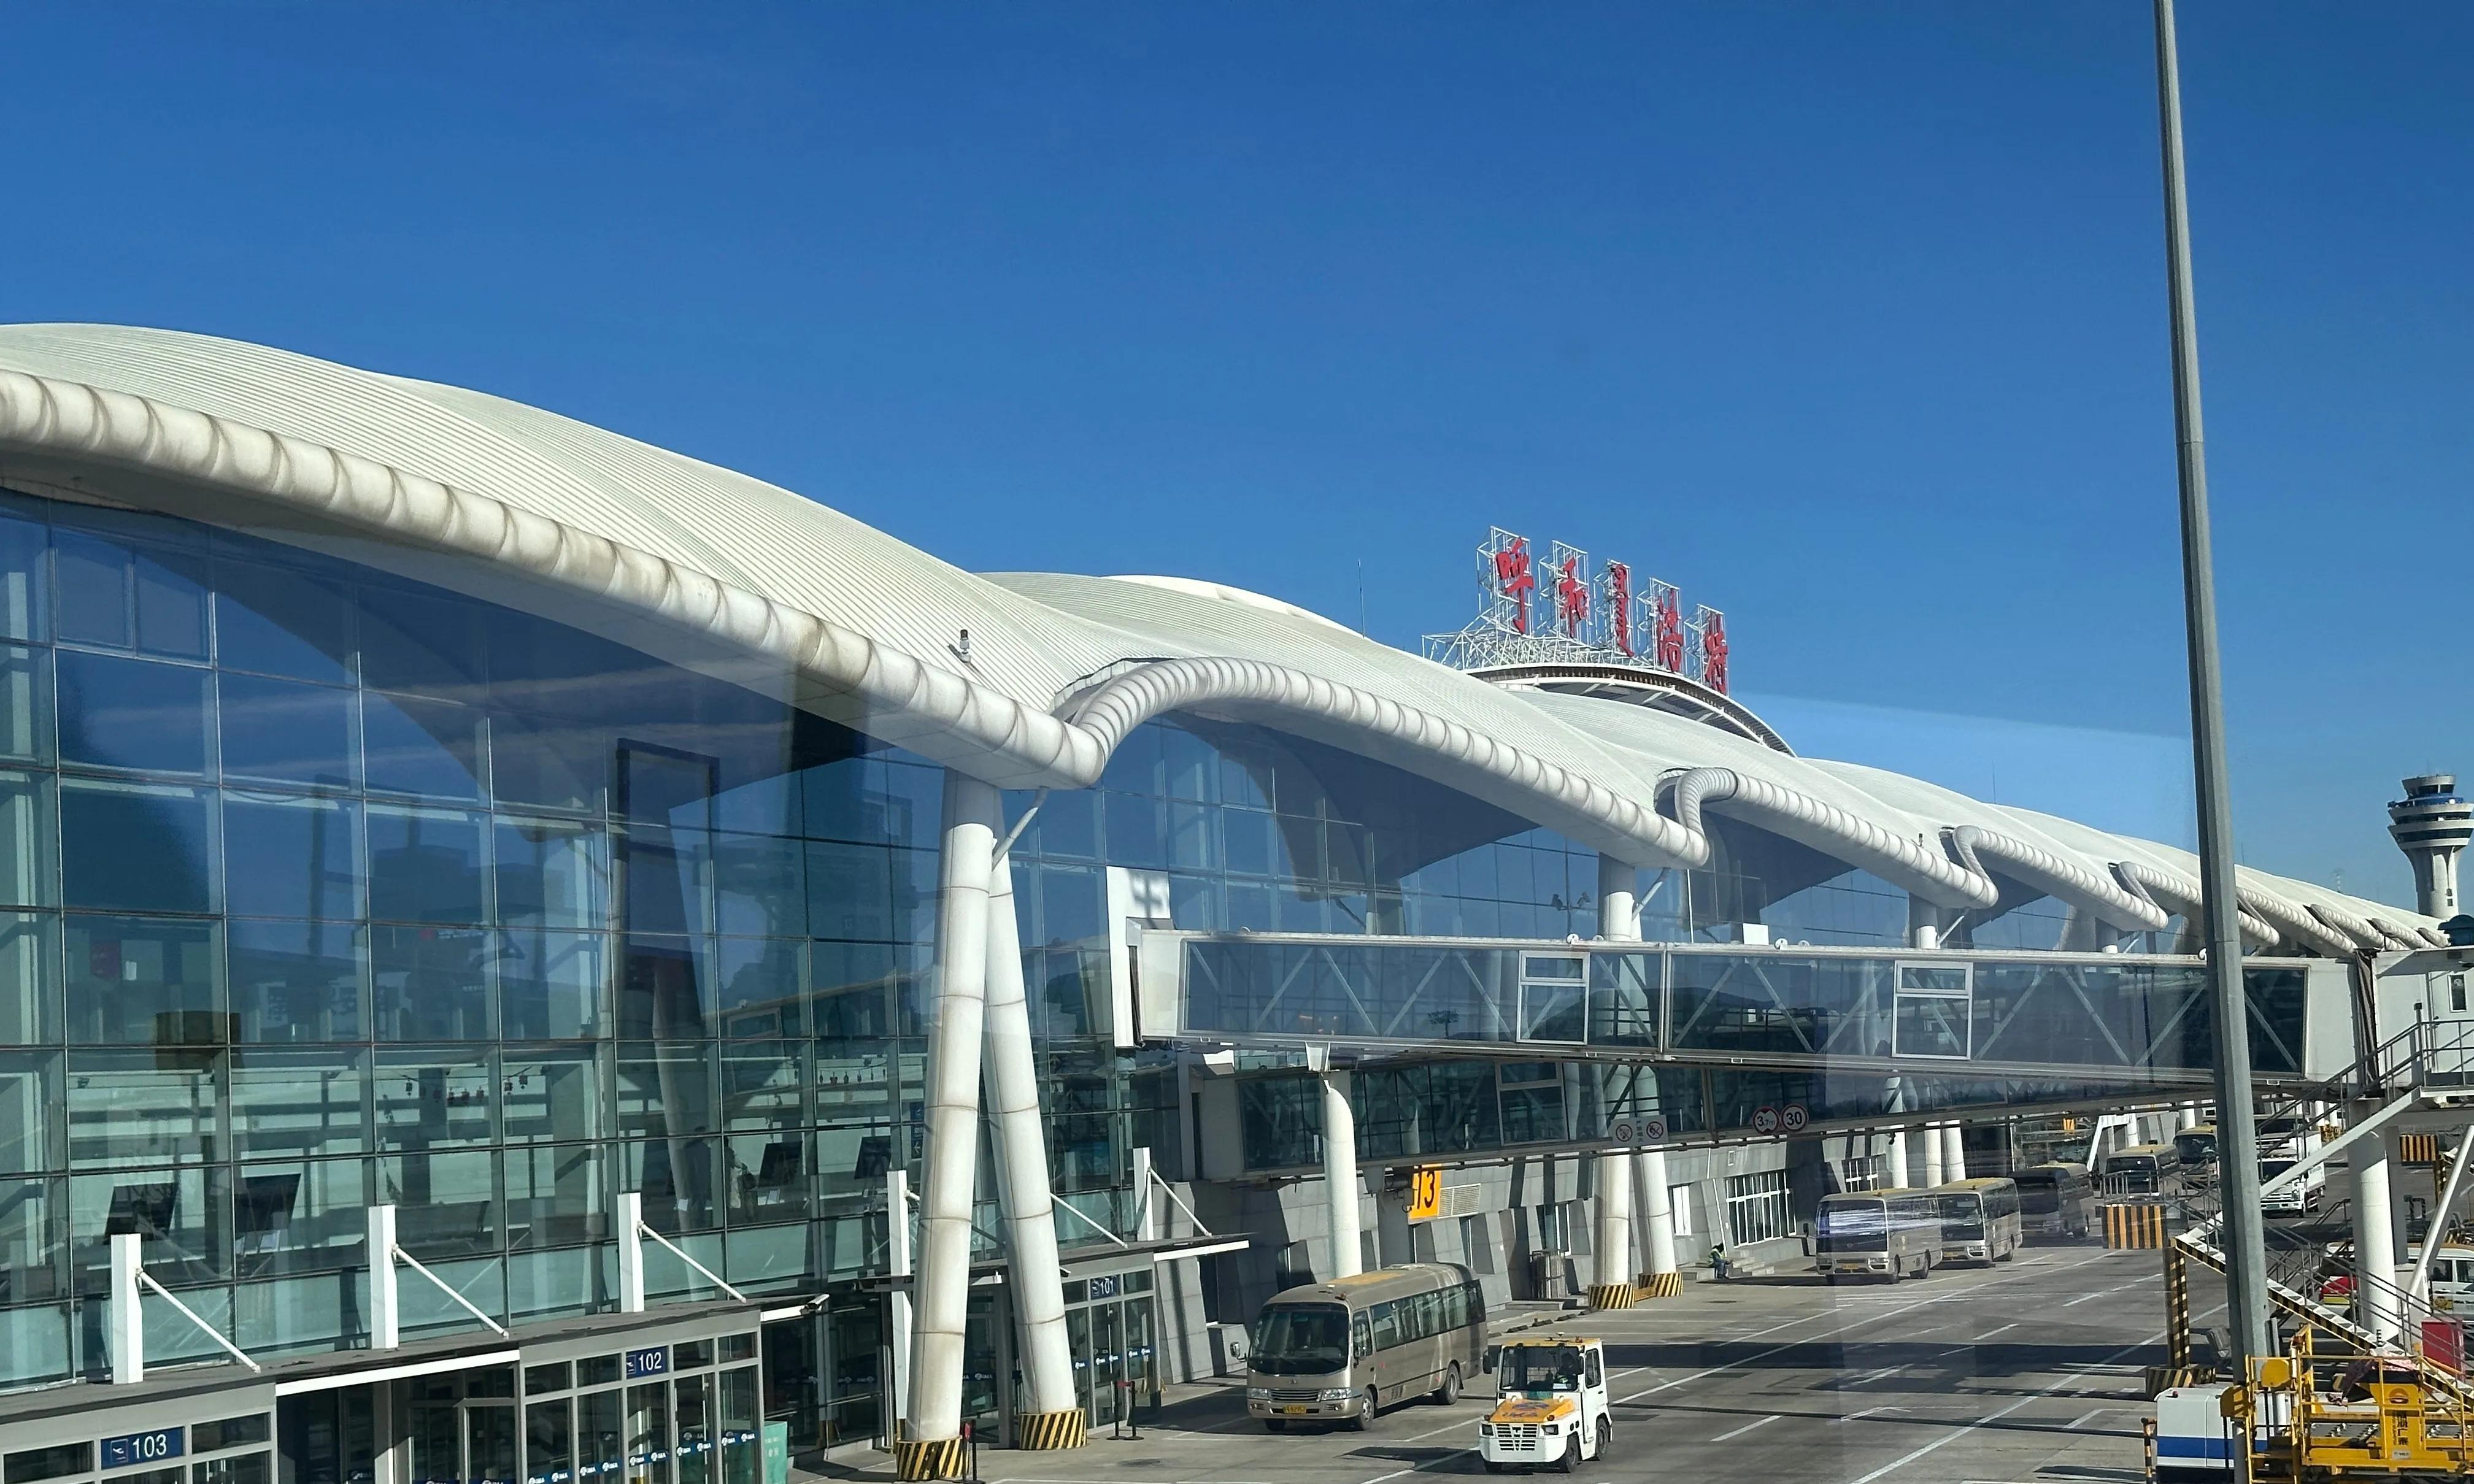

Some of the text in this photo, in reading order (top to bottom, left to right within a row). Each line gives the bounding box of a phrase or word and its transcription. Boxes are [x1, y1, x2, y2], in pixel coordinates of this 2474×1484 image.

[1786, 1112, 1802, 1126] 30
[1417, 1169, 1435, 1209] 13
[638, 1351, 662, 1371] 102
[133, 1434, 167, 1459] 103
